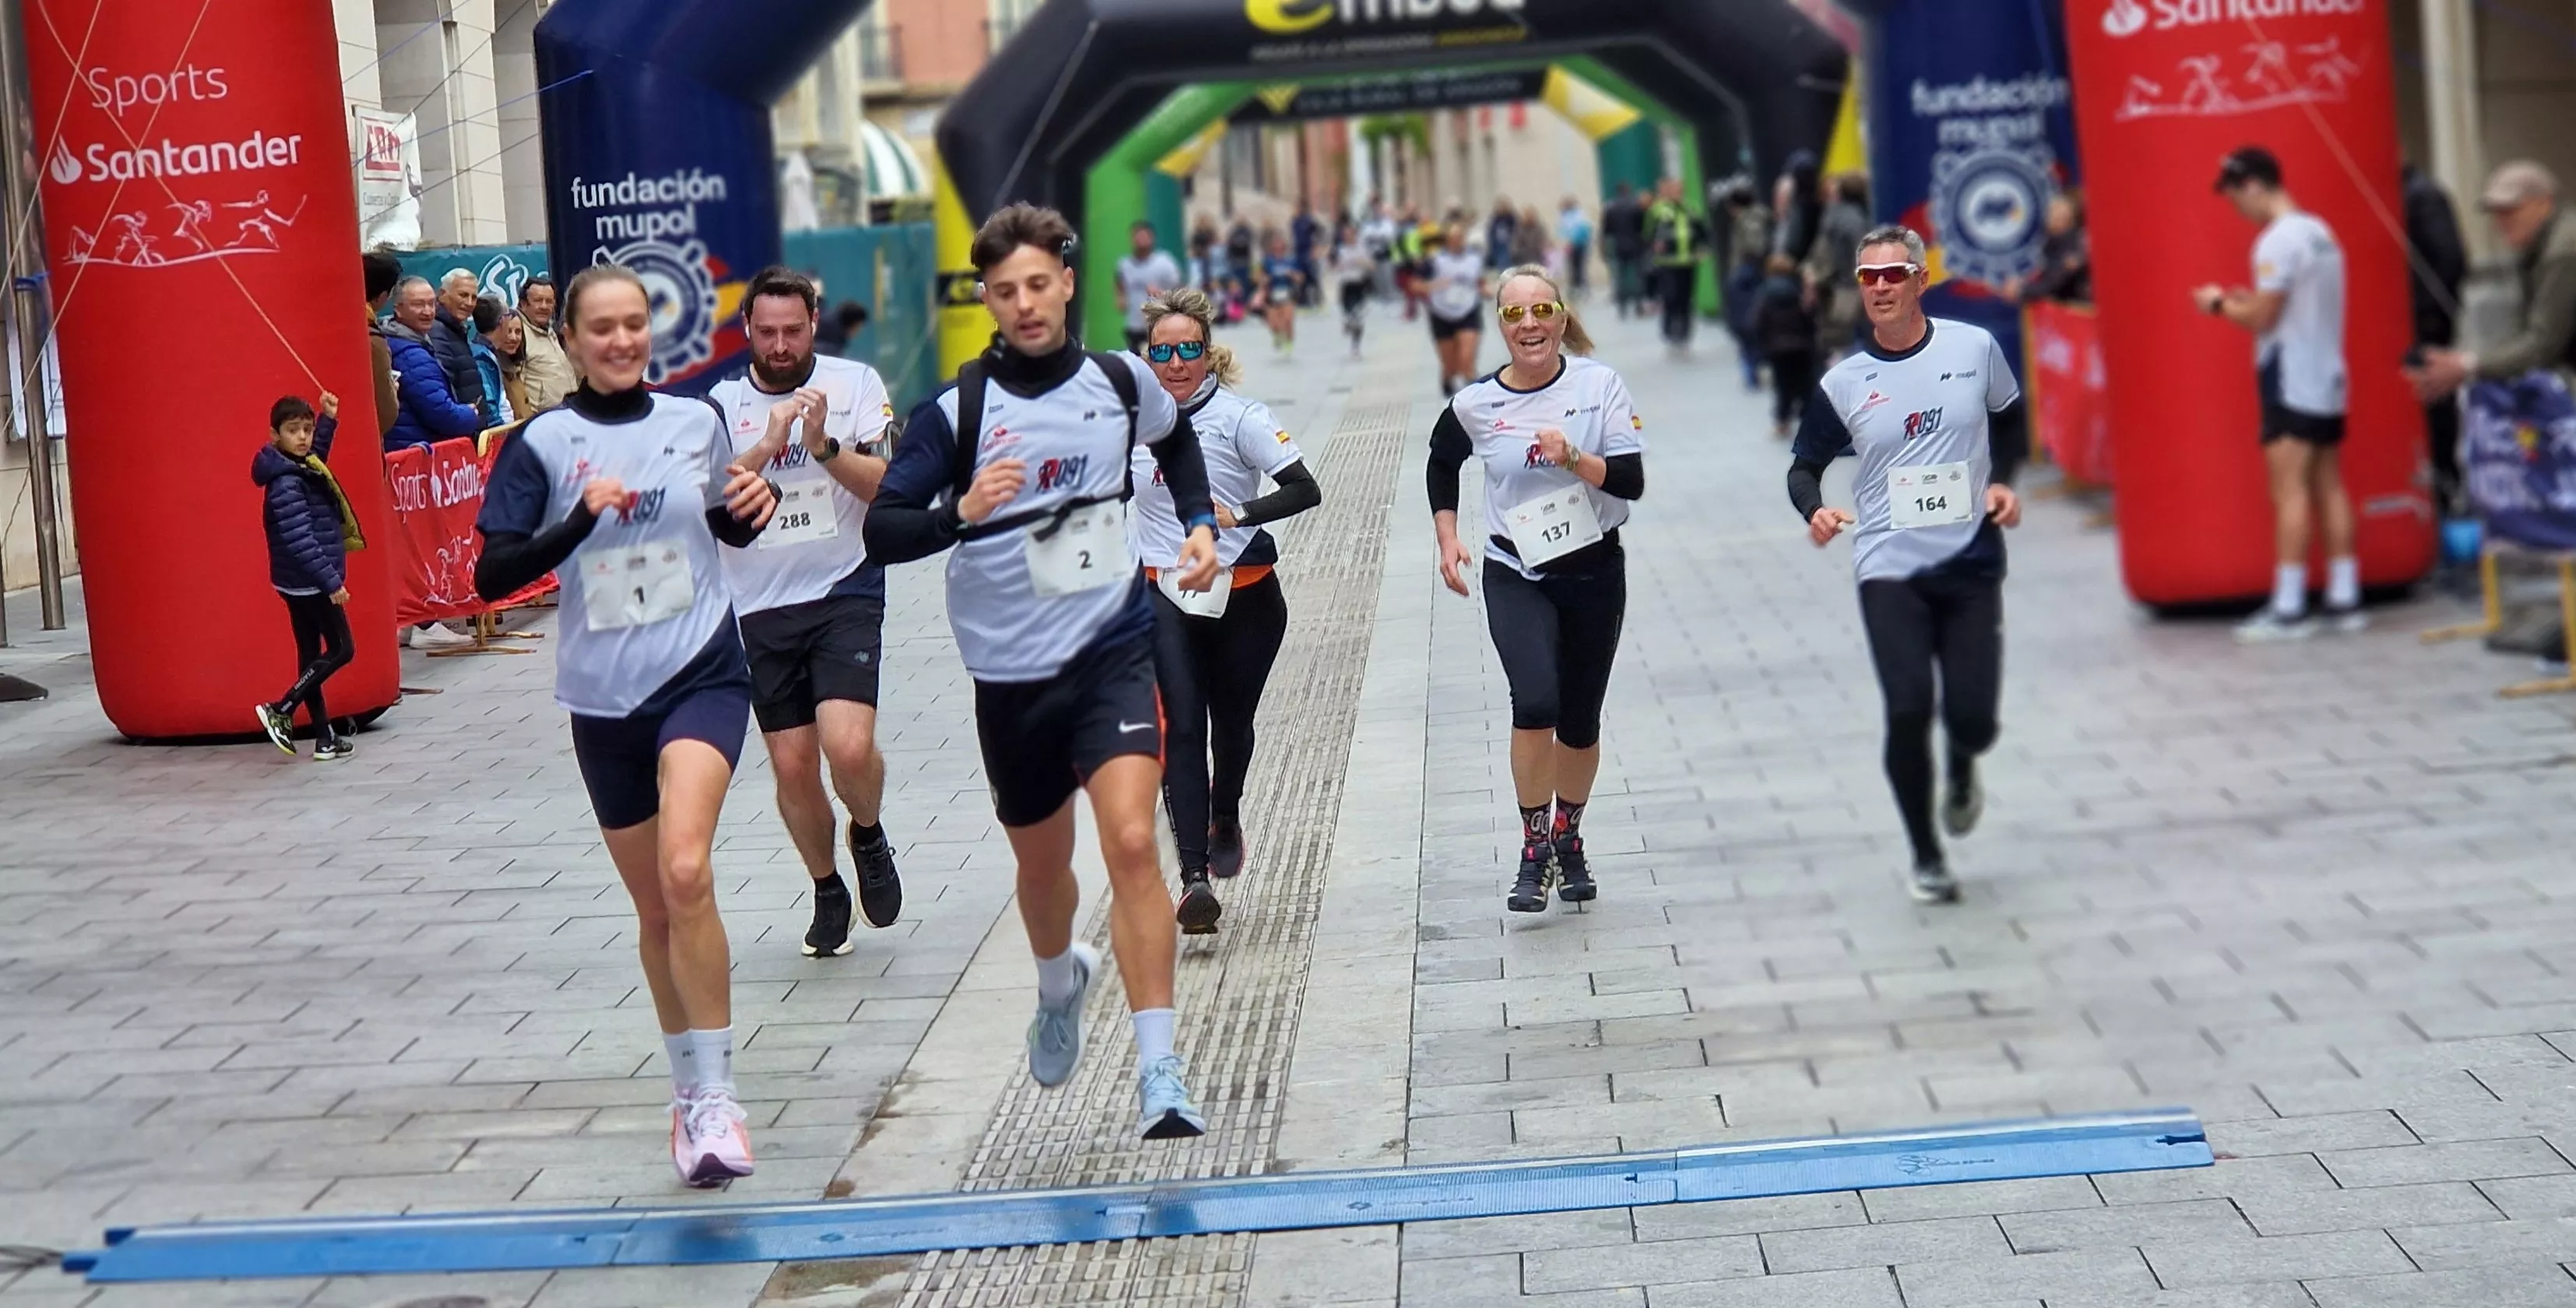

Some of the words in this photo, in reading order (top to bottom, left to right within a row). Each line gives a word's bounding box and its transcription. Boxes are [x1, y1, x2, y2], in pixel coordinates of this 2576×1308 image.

[89, 63, 227, 117] Sports
[87, 130, 301, 182] Santander
[571, 167, 727, 209] fundación
[596, 203, 697, 243] mupol
[1915, 495, 1948, 512] 164
[779, 512, 811, 530] 288
[1542, 520, 1571, 543] 137
[1078, 550, 1093, 570] 2
[633, 585, 645, 605] 1
